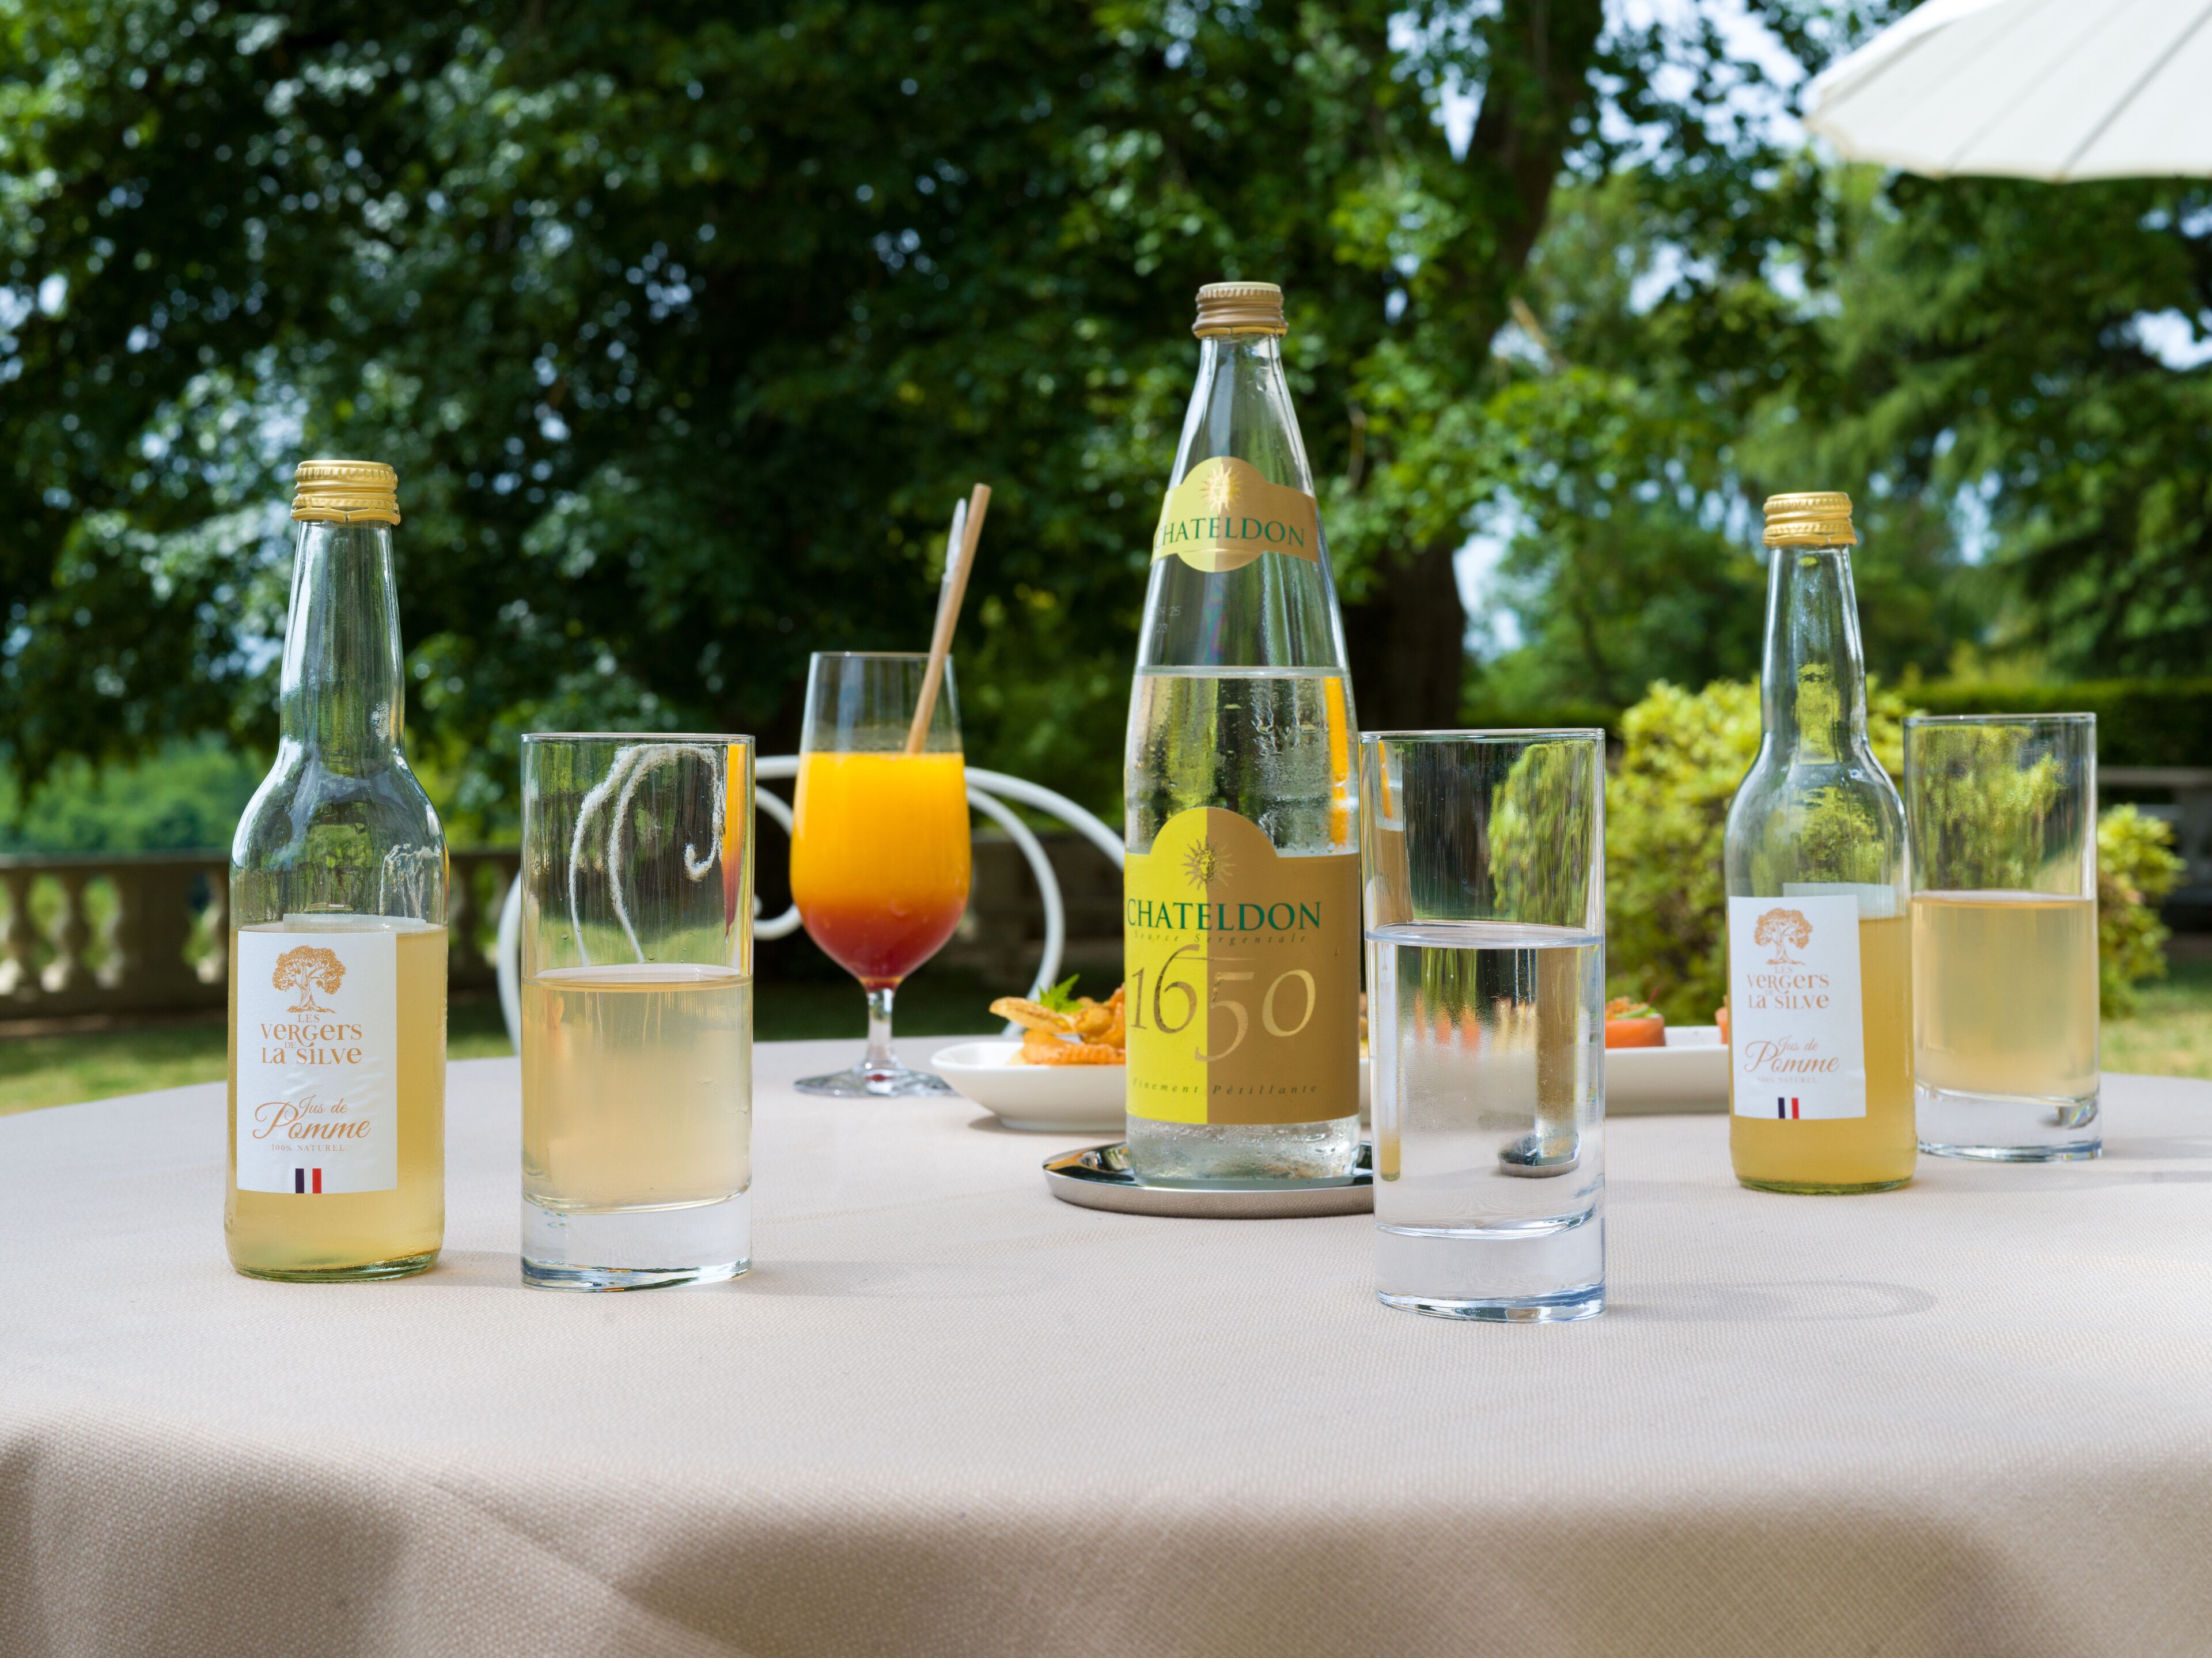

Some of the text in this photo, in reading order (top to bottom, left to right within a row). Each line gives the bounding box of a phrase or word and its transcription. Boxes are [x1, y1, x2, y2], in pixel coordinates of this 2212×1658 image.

[1155, 517, 1305, 548] CHATELDON
[1169, 605, 1181, 616] 25
[1127, 898, 1321, 931] CHATELDON
[1134, 930, 1305, 946] Source Sergentale
[1131, 944, 1316, 1062] 1650
[297, 1014, 320, 1023] LES
[1744, 1039, 1840, 1073] Pomme
[1767, 1035, 1819, 1057] Jus de
[1133, 1077, 1317, 1095] Finement Pétillante
[252, 1101, 371, 1139] Pomme
[285, 1095, 348, 1122] Jus de
